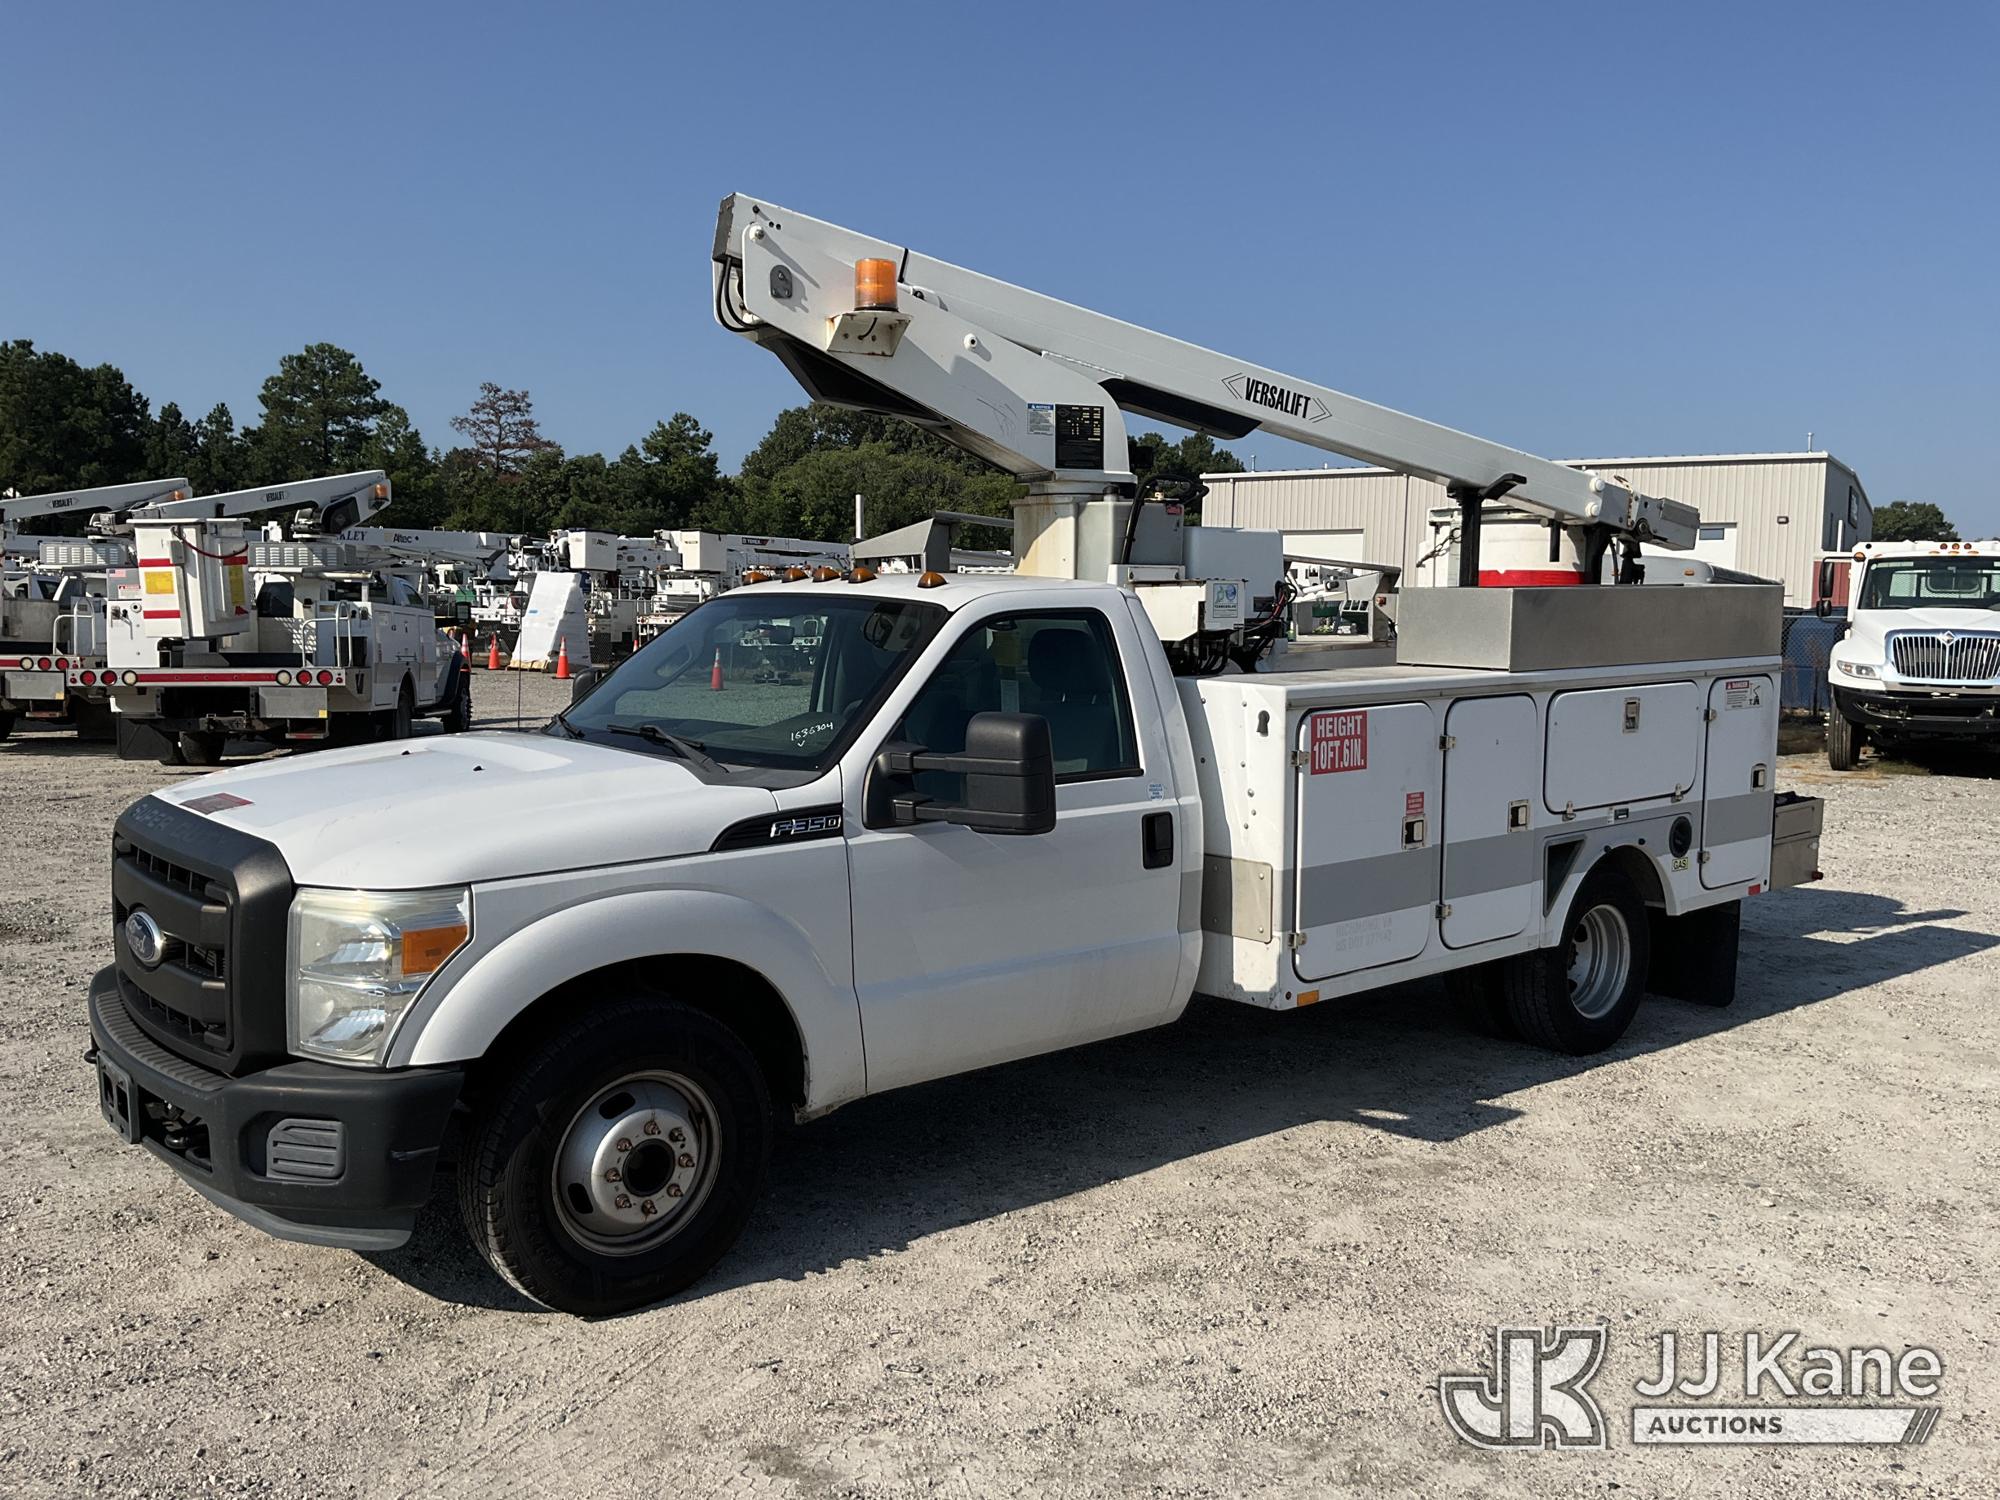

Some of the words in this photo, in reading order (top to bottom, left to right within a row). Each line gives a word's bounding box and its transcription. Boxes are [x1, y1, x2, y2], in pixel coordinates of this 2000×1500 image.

[1244, 376, 1311, 419] VERSALIFT
[265, 490, 285, 502] VERSALIFT
[52, 497, 73, 509] VERSALIFT
[393, 533, 412, 544] Altec
[791, 721, 834, 741] 1636304
[1316, 714, 1363, 738] HEIGHT
[1673, 859, 1687, 870] GAS
